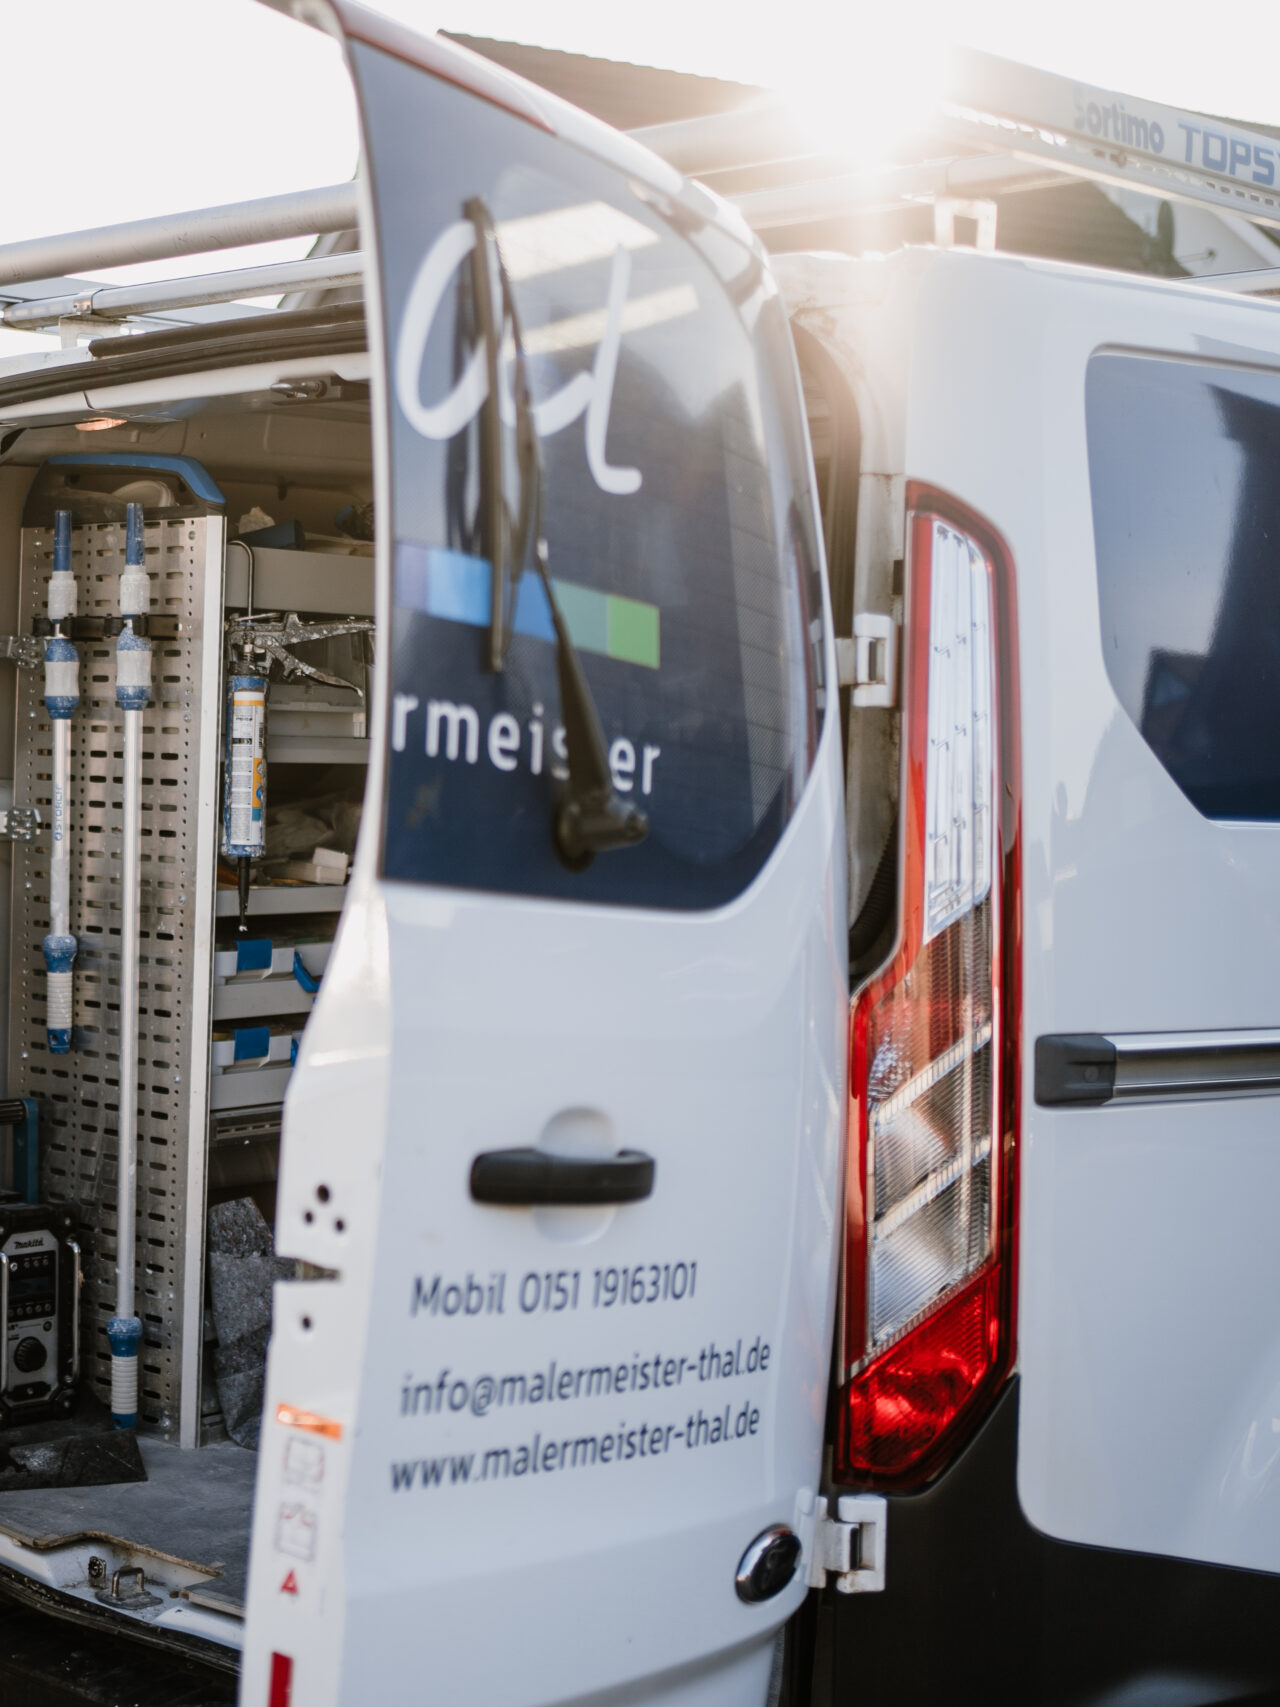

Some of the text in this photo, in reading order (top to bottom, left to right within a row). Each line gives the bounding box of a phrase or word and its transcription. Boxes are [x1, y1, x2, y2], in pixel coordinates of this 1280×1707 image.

[1177, 122, 1280, 187] TOPS
[391, 692, 661, 796] rmeiser
[410, 1260, 698, 1319] Mobil 0151 19163101
[400, 1335, 772, 1418] info@malermeister-thal.de
[390, 1400, 761, 1494] www.malermeister-thal.de
